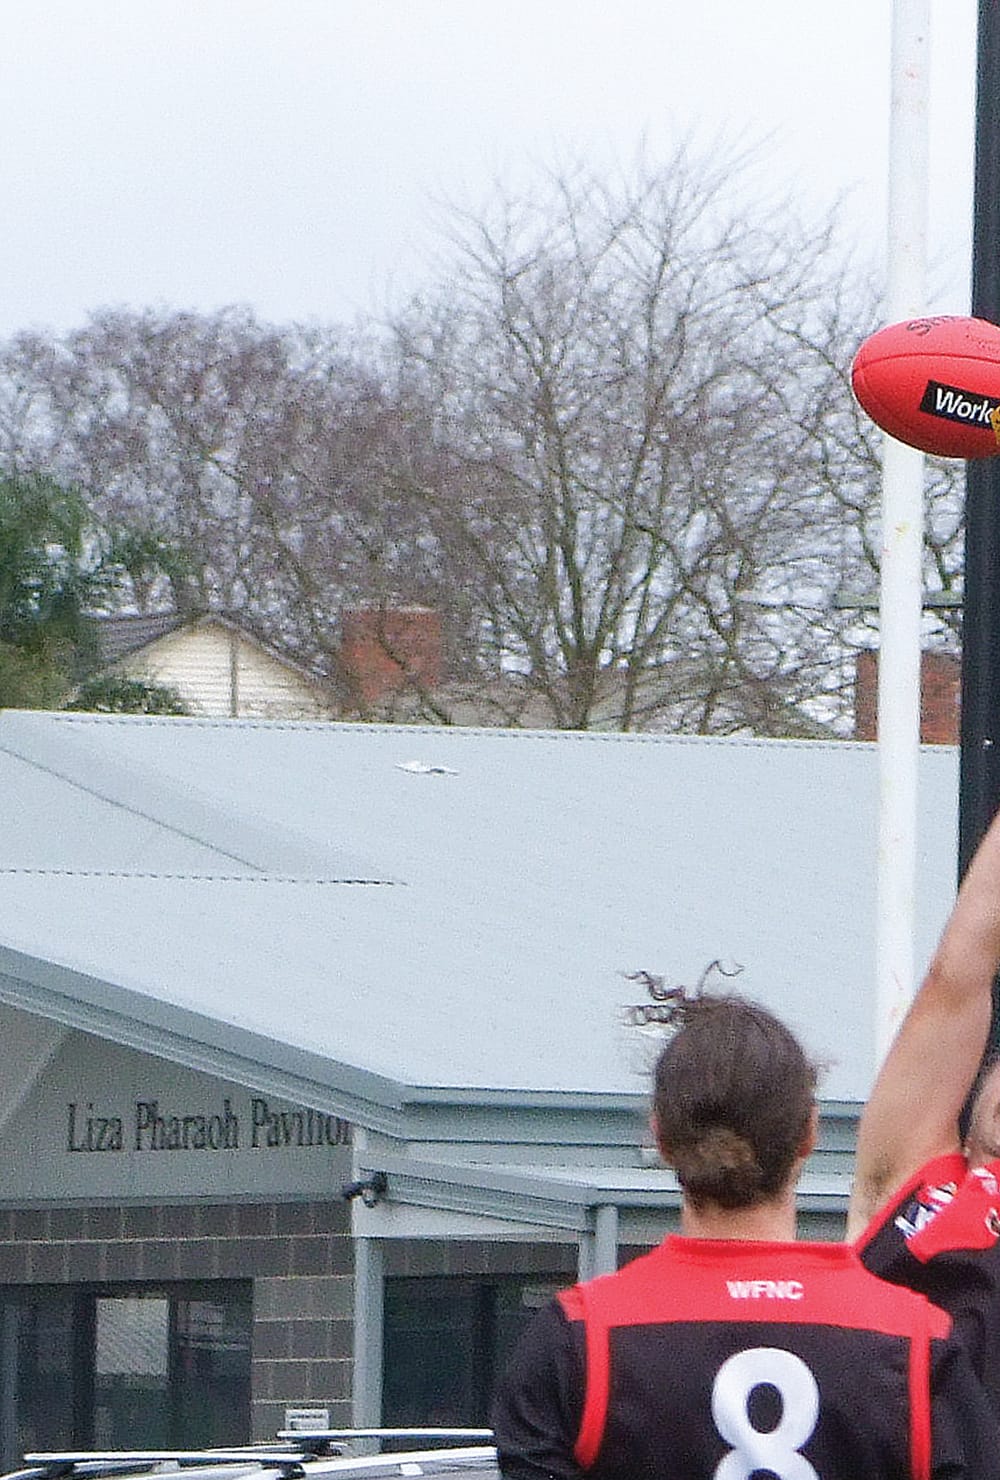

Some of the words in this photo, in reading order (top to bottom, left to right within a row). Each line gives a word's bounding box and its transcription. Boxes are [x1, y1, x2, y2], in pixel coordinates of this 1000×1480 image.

[66, 1102, 123, 1152] Liza
[135, 1099, 239, 1151] Pharaoh
[725, 1280, 804, 1300] WFNC
